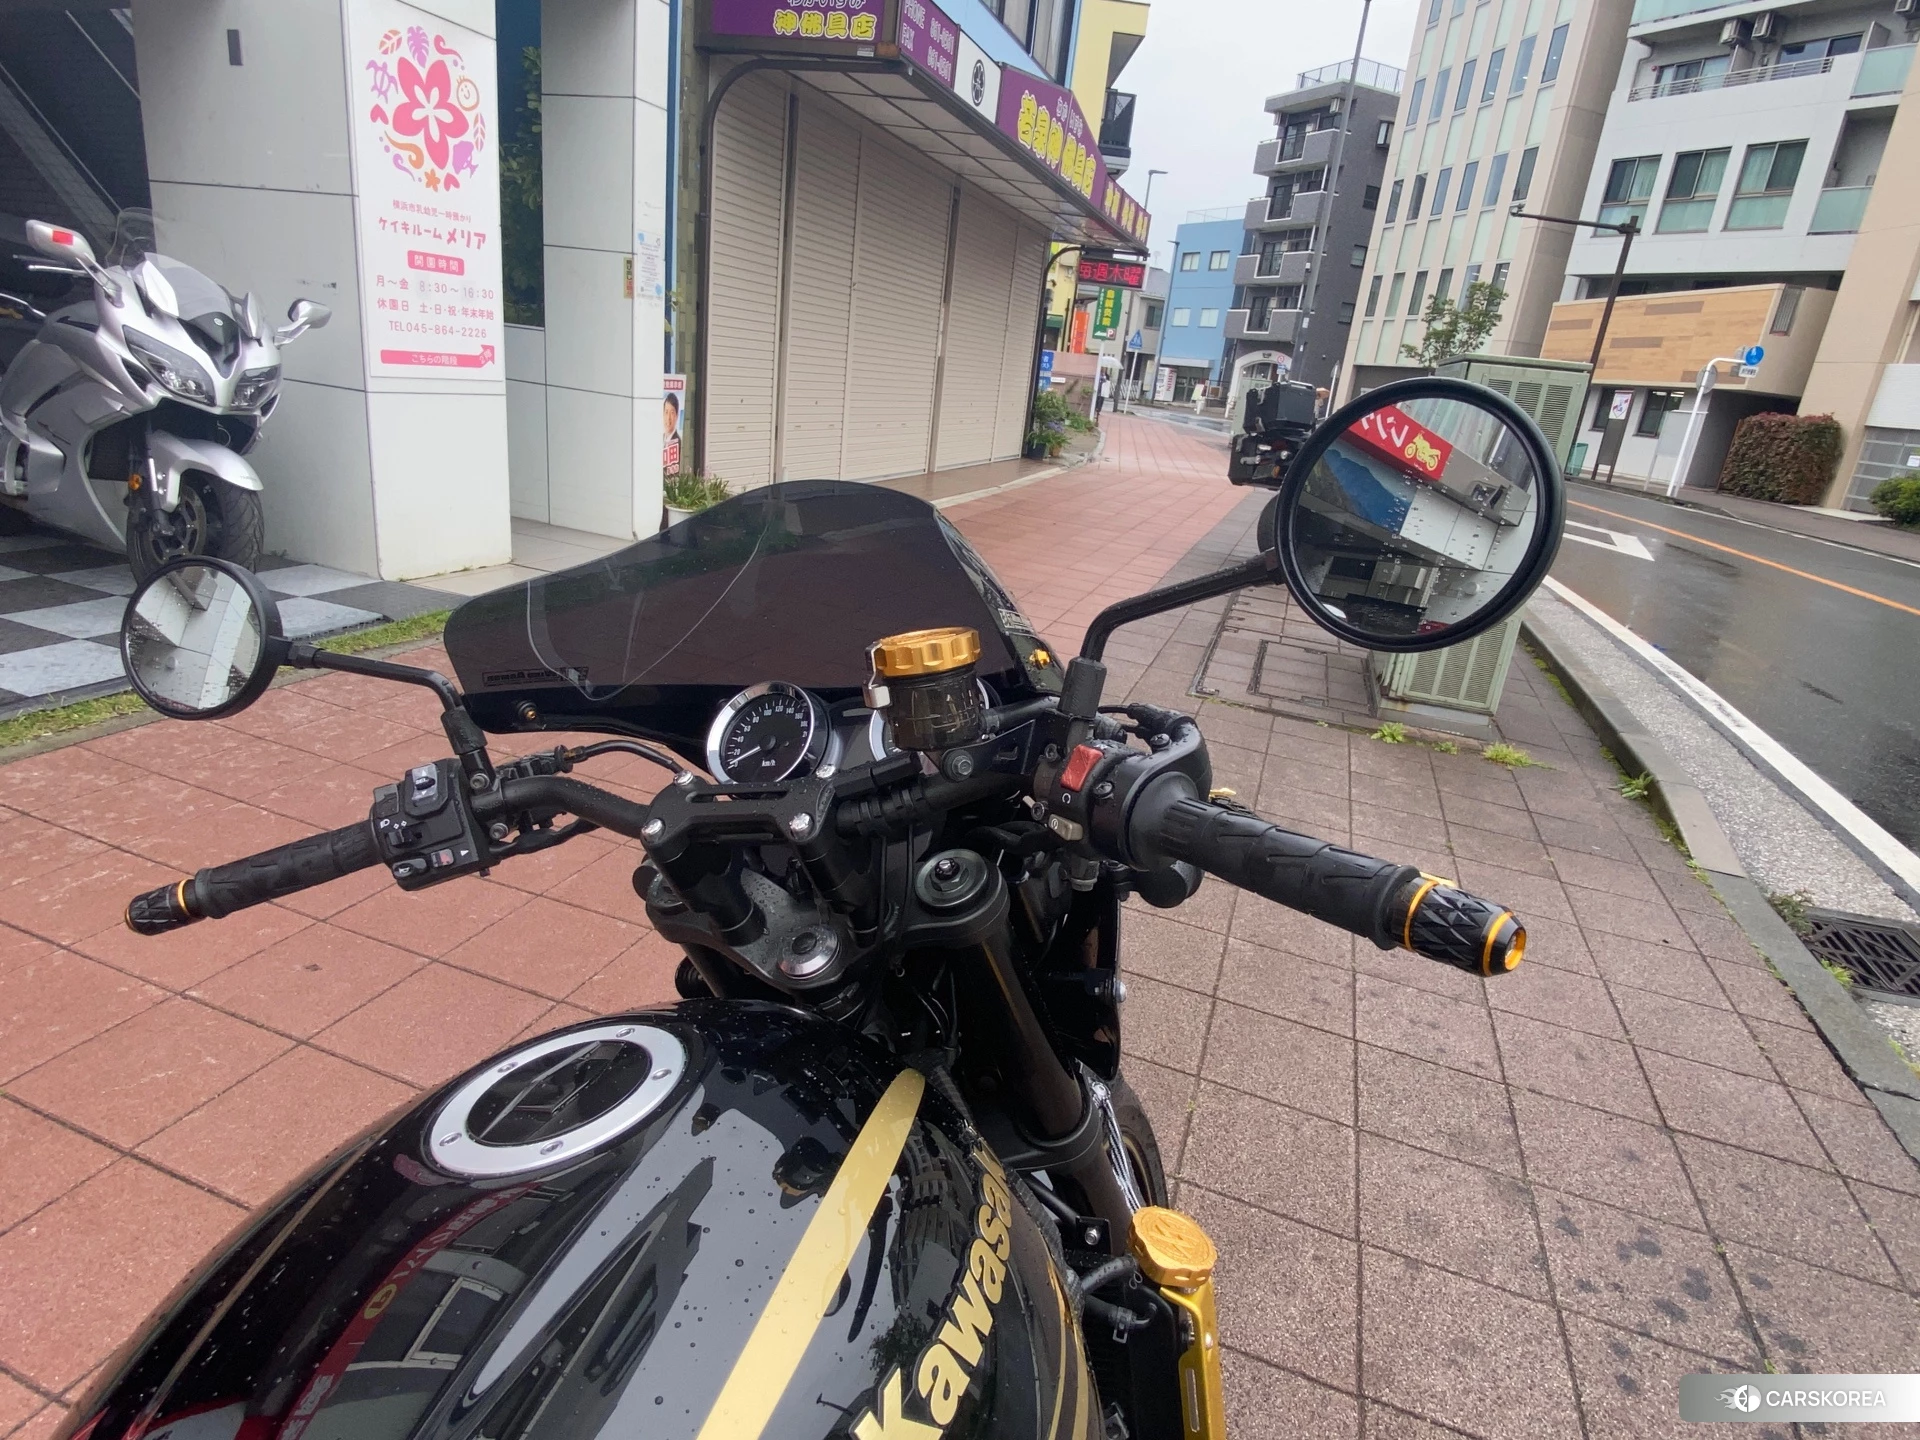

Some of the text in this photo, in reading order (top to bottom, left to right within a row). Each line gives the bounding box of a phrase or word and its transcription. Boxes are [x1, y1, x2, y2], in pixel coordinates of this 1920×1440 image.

[904, 0, 926, 29] PHONE
[901, 22, 915, 51] FAX
[379, 217, 486, 250] ケイキルーム メリア
[414, 254, 459, 272] 開園時間
[1079, 262, 1142, 286] 毎週木曜
[377, 298, 409, 312] 休園日
[762, 759, 776, 767] km/h
